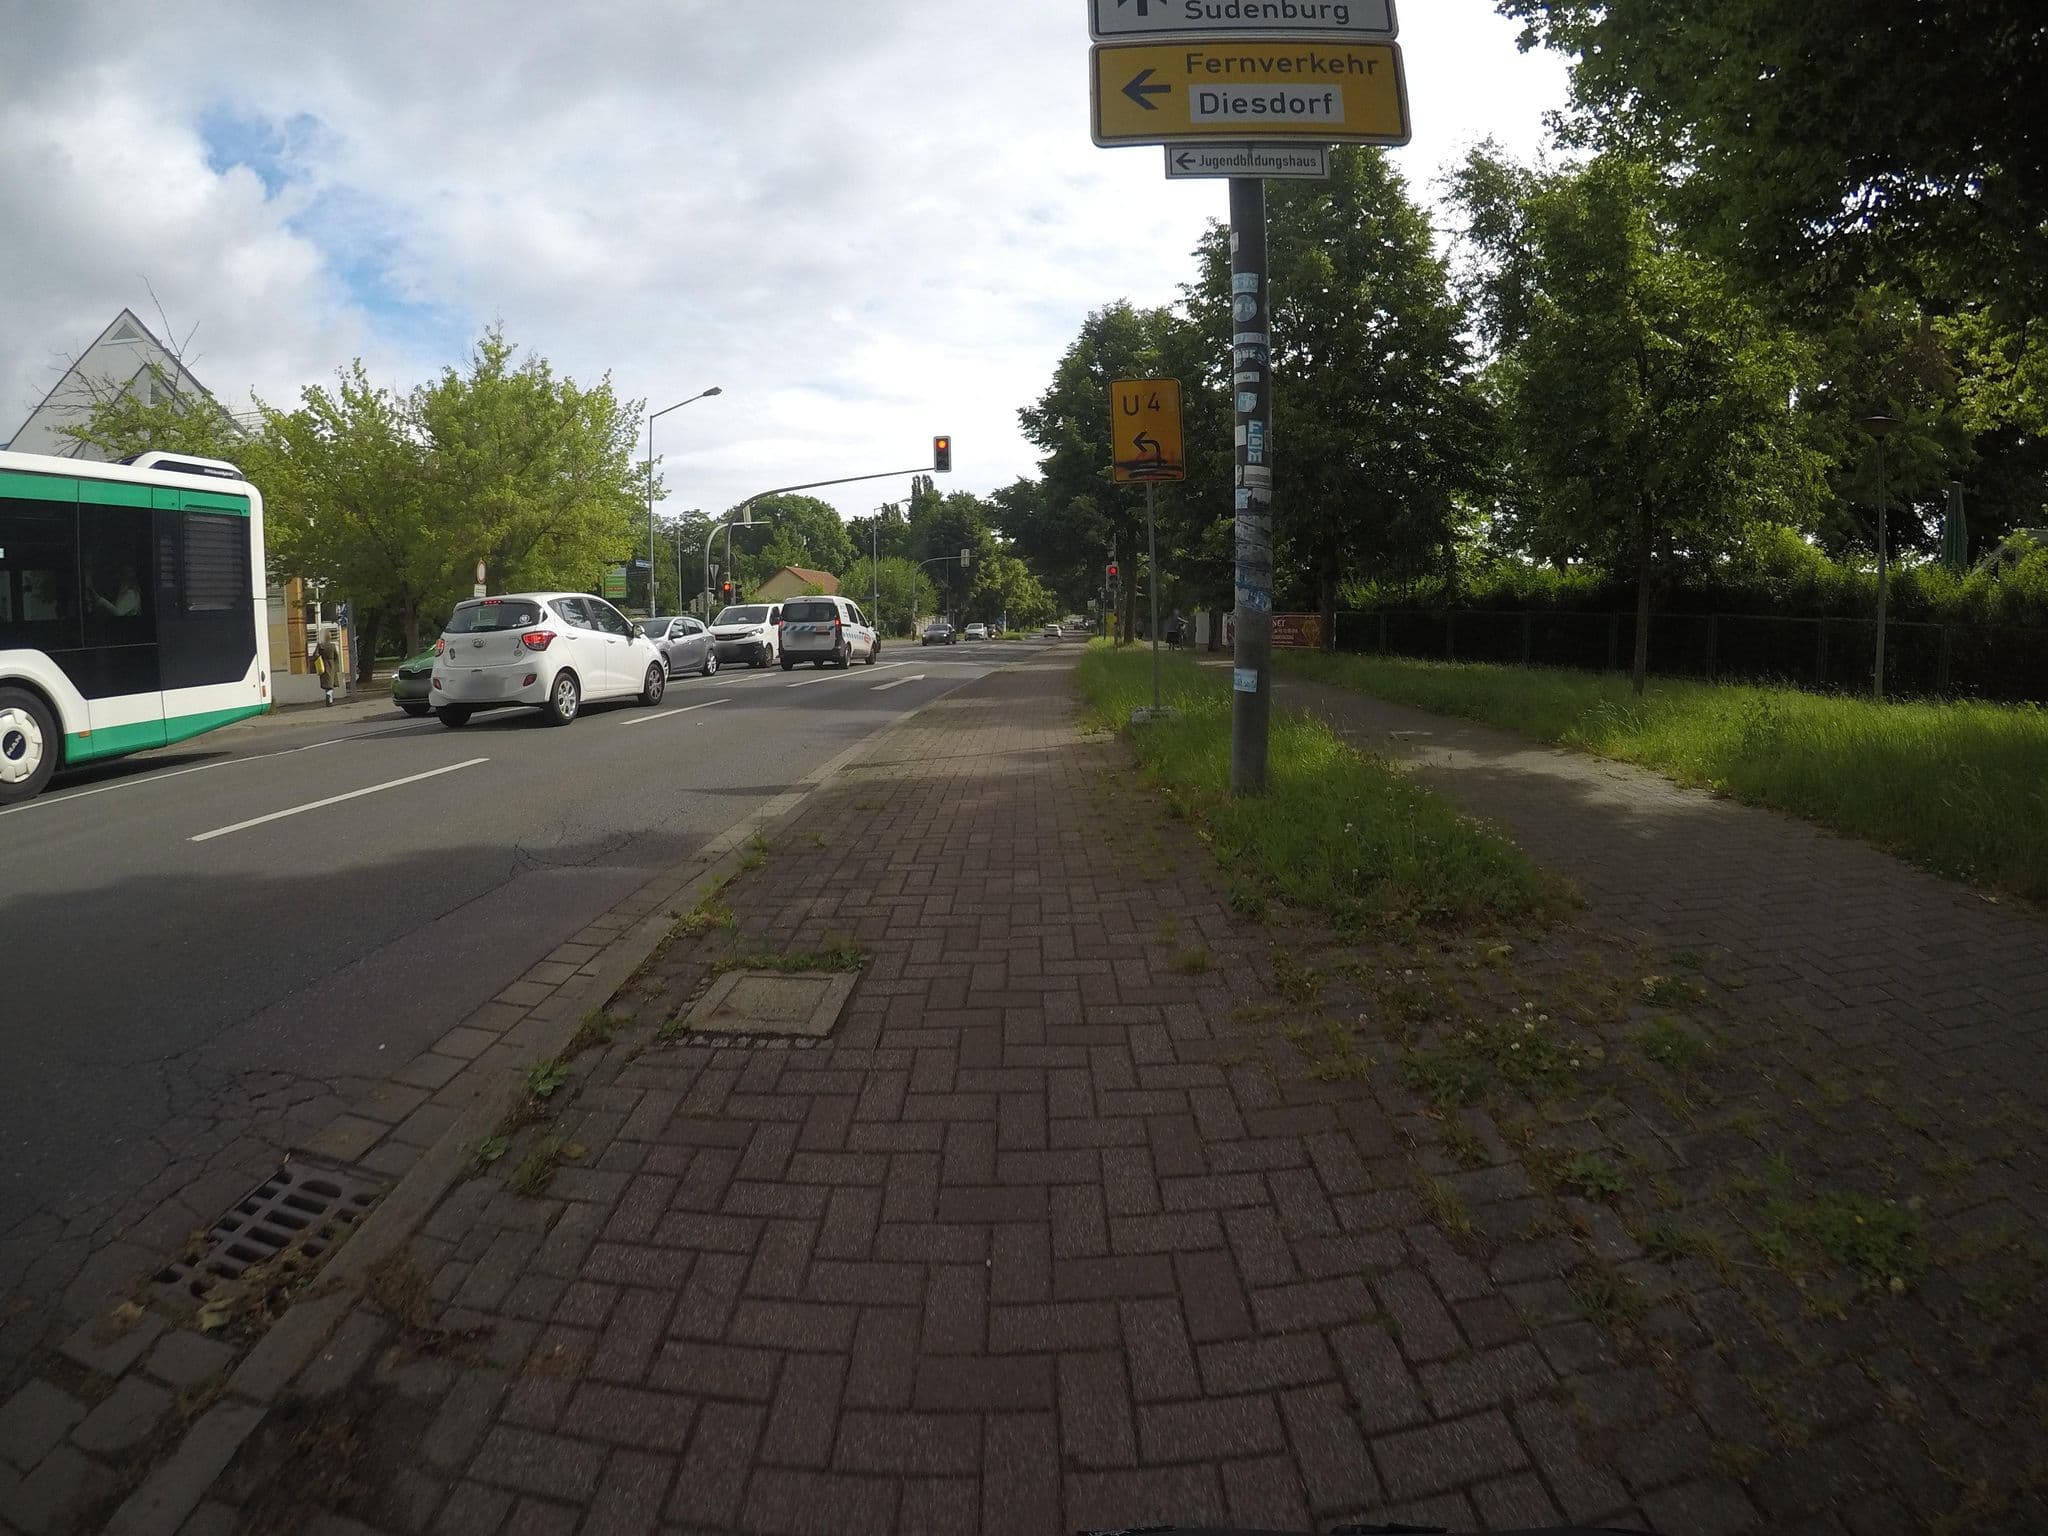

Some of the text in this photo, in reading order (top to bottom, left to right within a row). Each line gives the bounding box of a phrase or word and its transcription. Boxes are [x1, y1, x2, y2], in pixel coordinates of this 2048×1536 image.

[1185, 0, 1350, 25] Sudenburg
[1186, 52, 1379, 75] Fernverkehr
[1200, 92, 1333, 115] Diesdorf
[1199, 153, 1317, 169] Jugendbildungshaus
[1122, 391, 1161, 416] U 4
